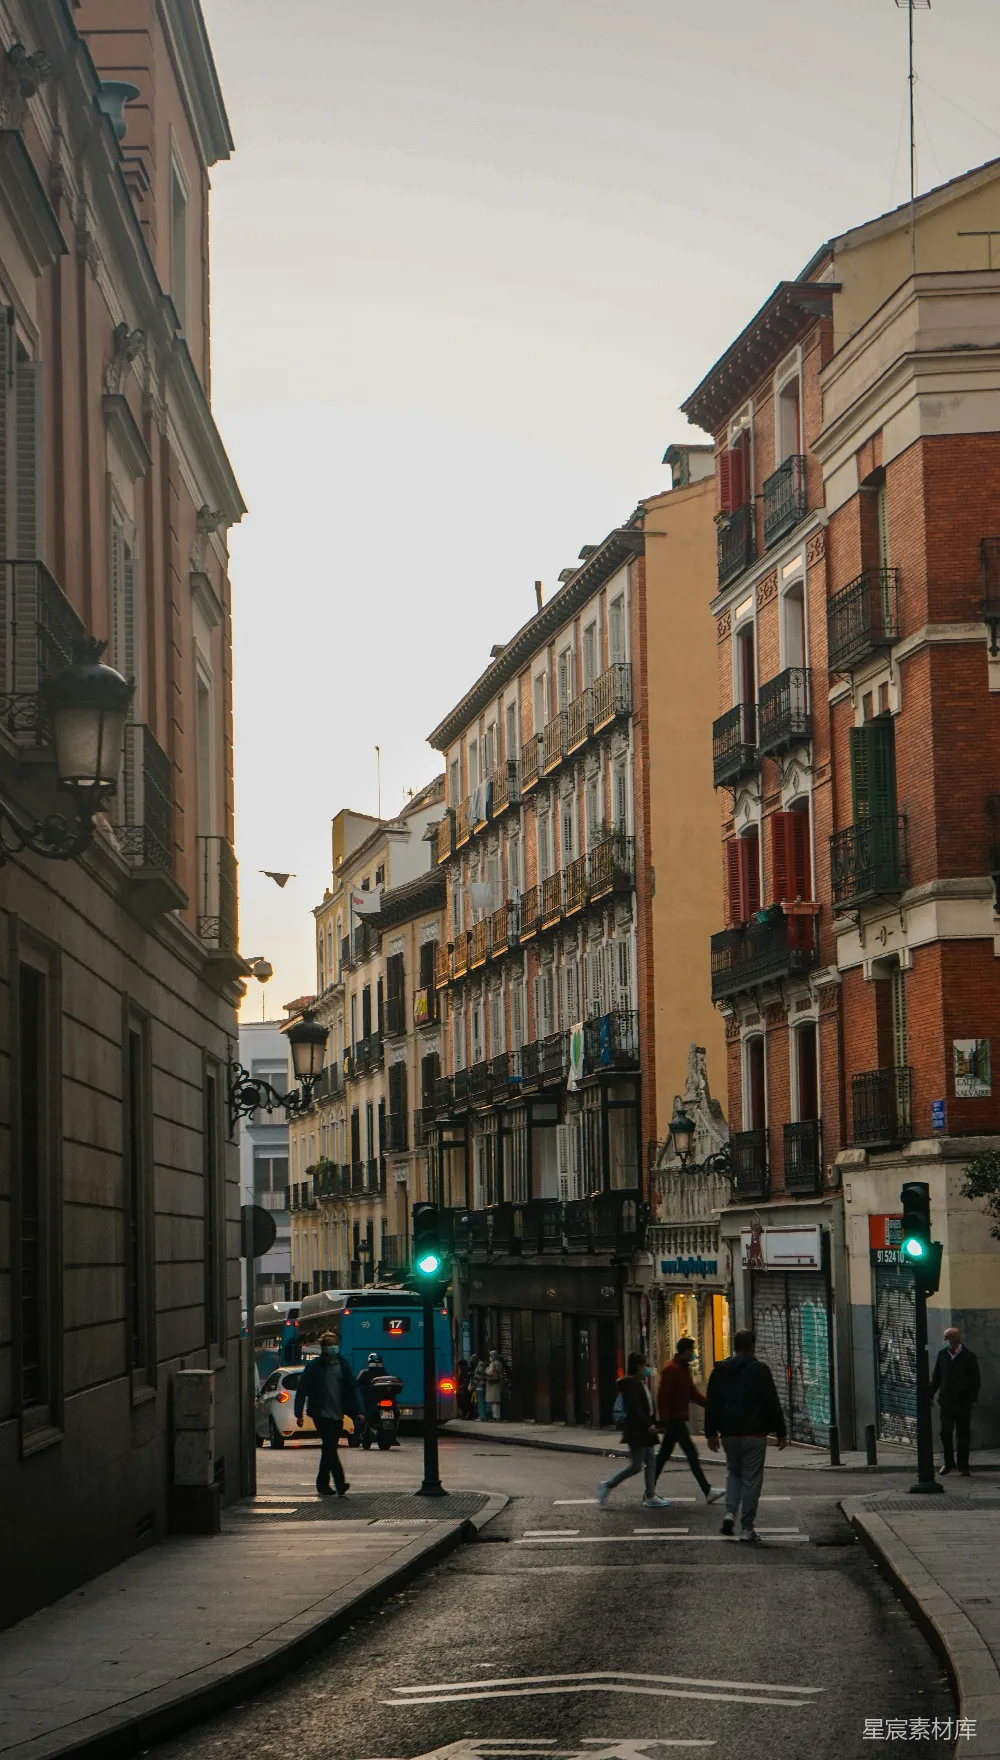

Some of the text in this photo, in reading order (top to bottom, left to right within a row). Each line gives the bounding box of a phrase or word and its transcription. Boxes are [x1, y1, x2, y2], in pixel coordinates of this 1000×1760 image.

[877, 1250, 884, 1263] 91
[884, 1250, 896, 1263] 524
[389, 1319, 403, 1329] 17
